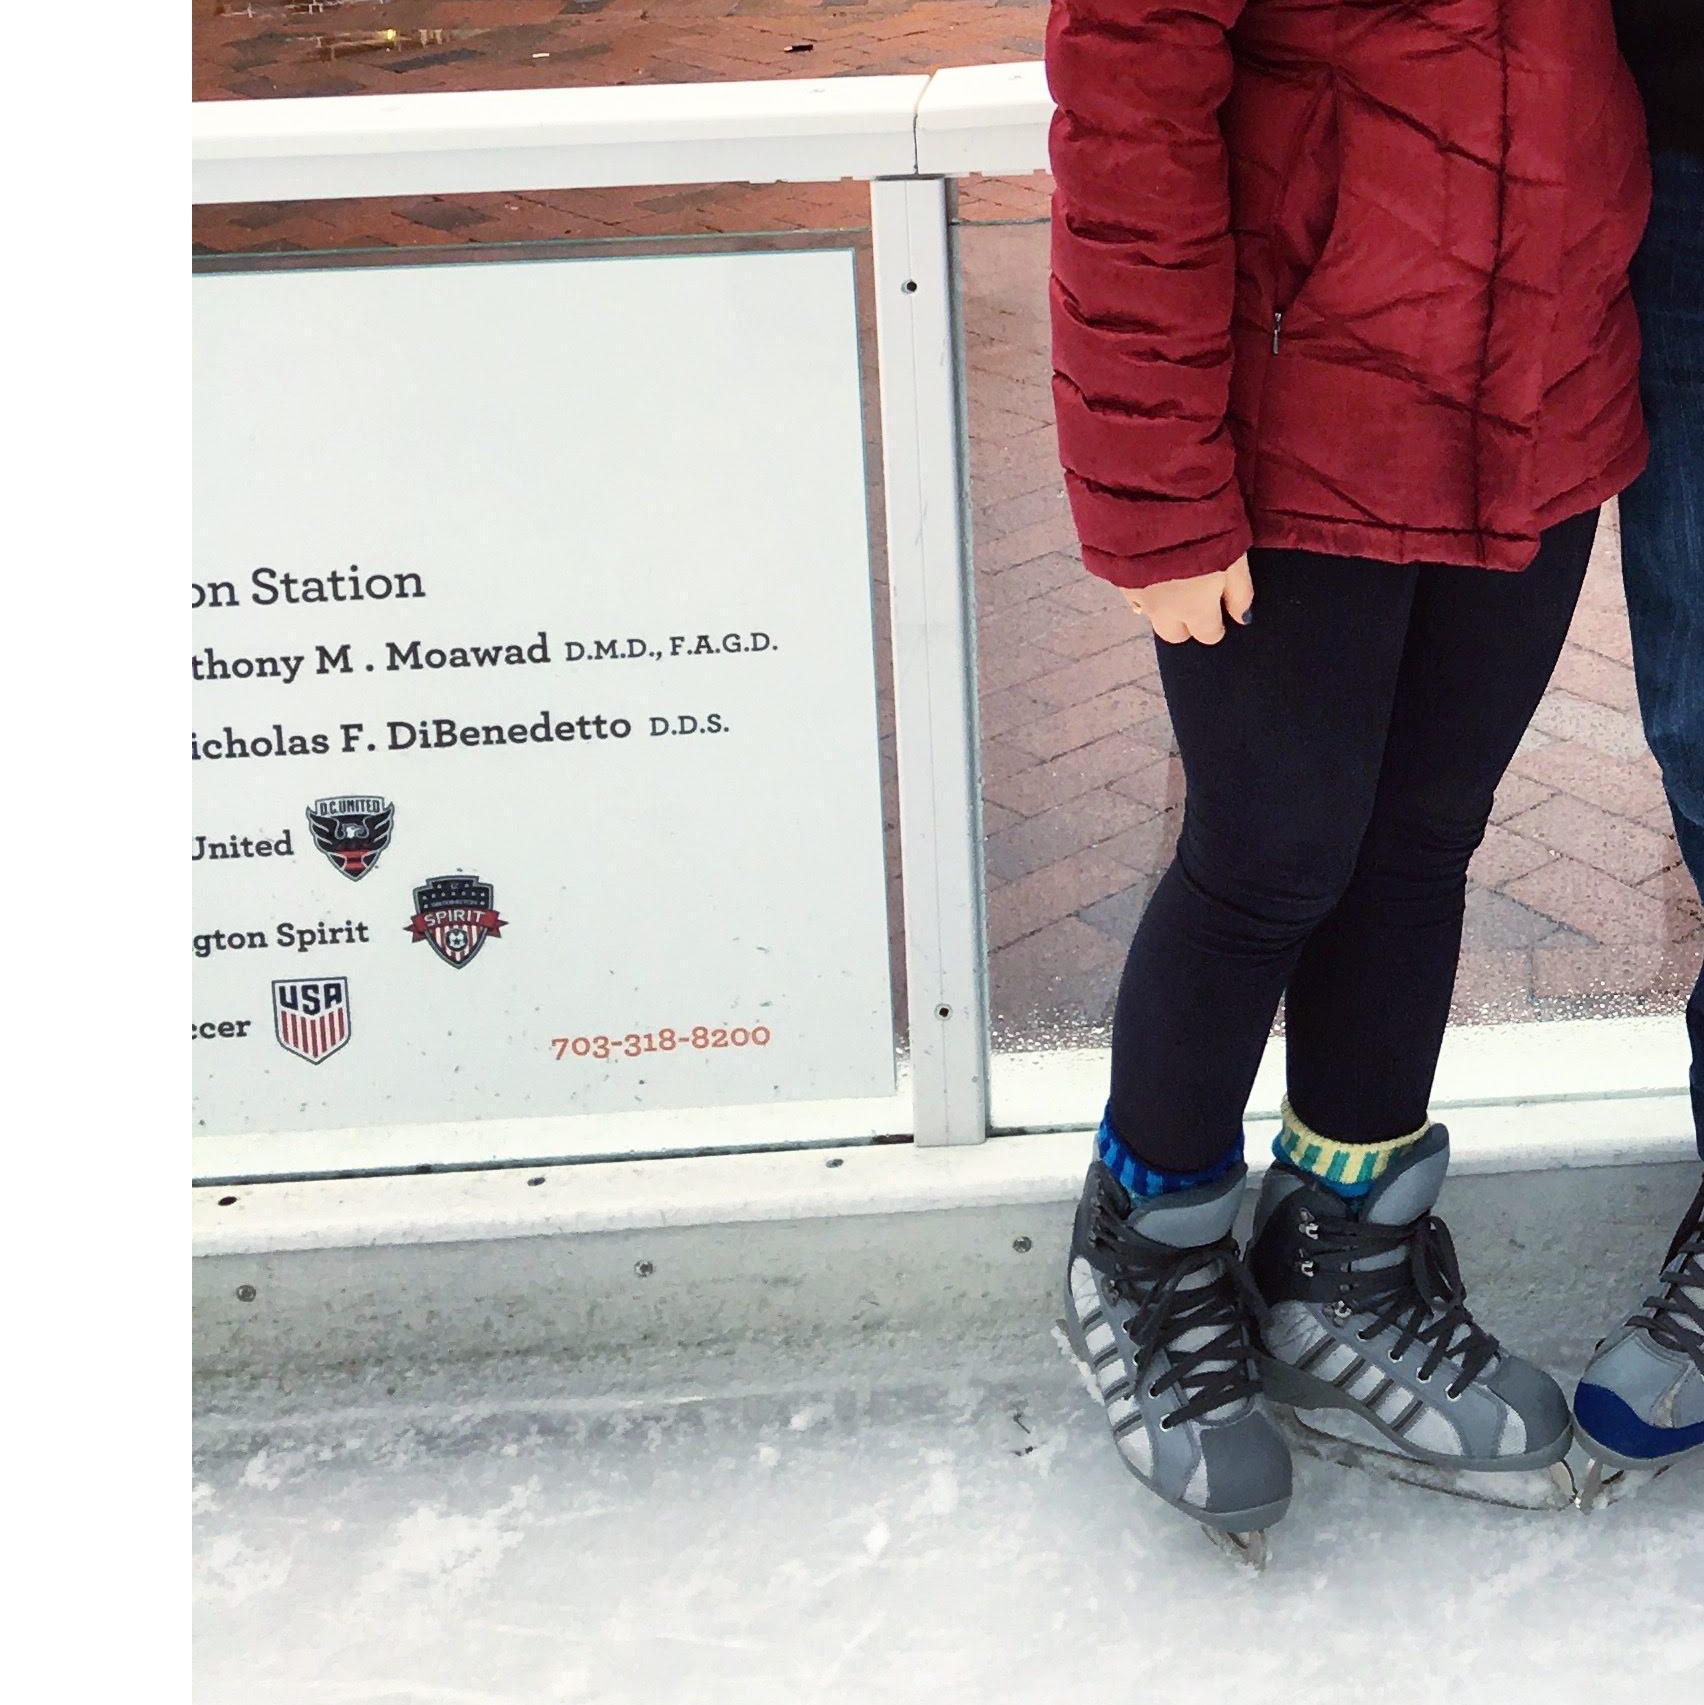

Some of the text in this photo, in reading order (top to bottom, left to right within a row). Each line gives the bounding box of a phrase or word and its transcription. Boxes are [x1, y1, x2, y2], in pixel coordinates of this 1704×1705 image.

[251, 564, 426, 606] Station
[191, 647, 305, 685] thony
[385, 631, 552, 672] Moawad
[564, 638, 663, 662] D.M.D.,
[669, 632, 778, 657] F.A.G.D.
[339, 723, 376, 753] F.
[386, 710, 632, 751] DiBenedetto
[649, 713, 730, 737] D.D.S.
[424, 909, 486, 927] SPIRIT
[192, 919, 370, 958] gton Spirit
[278, 983, 342, 1016] USA
[191, 1020, 252, 1041] cer
[549, 1023, 774, 1063] 703-318-8200
